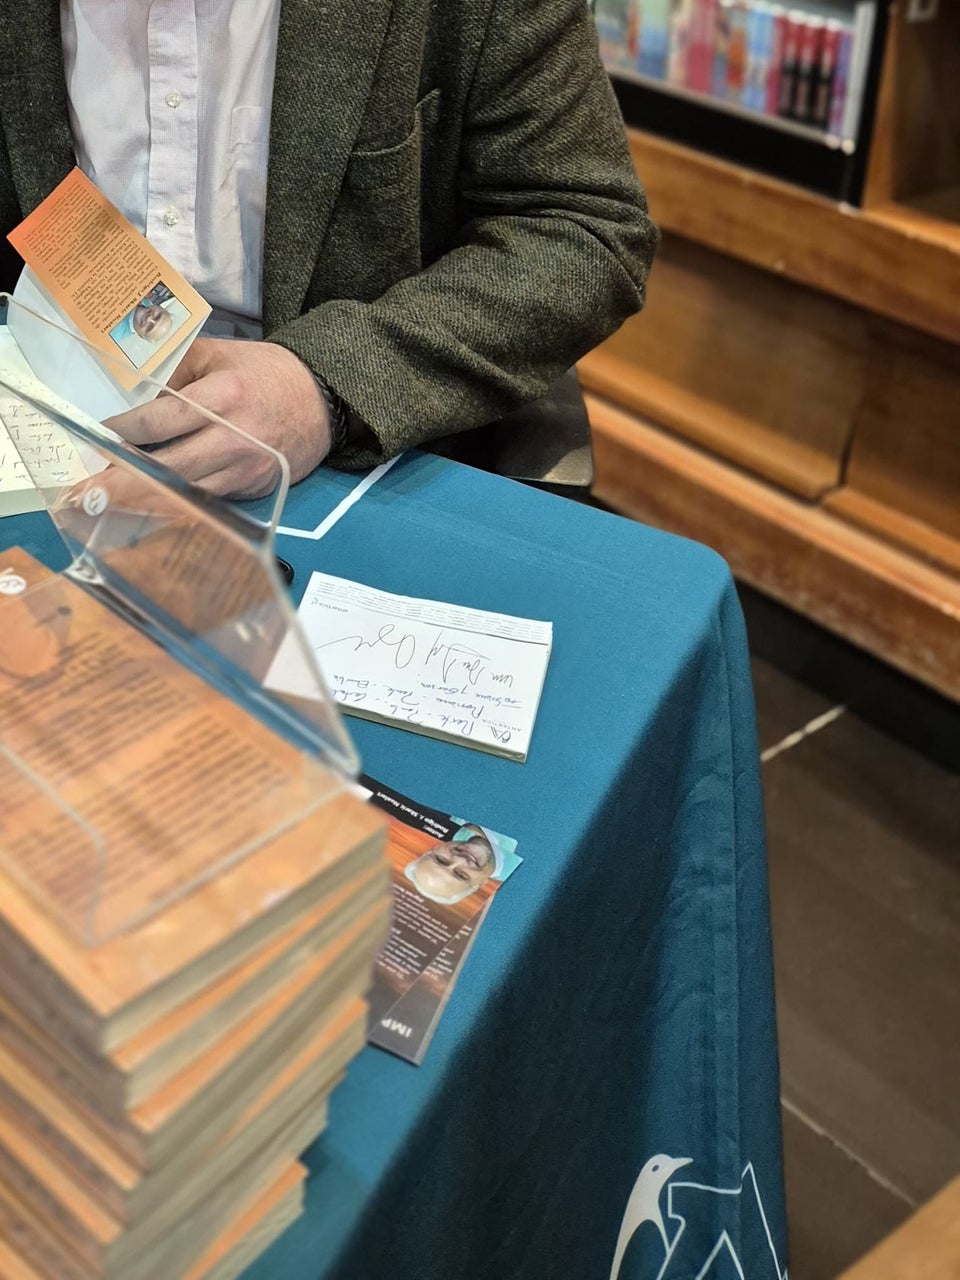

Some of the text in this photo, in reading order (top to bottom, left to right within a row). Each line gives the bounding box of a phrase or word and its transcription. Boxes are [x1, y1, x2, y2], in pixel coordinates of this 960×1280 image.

[375, 790, 400, 807] Nualart
[399, 803, 419, 817] Skaric
[423, 816, 449, 833] Rodrigo
